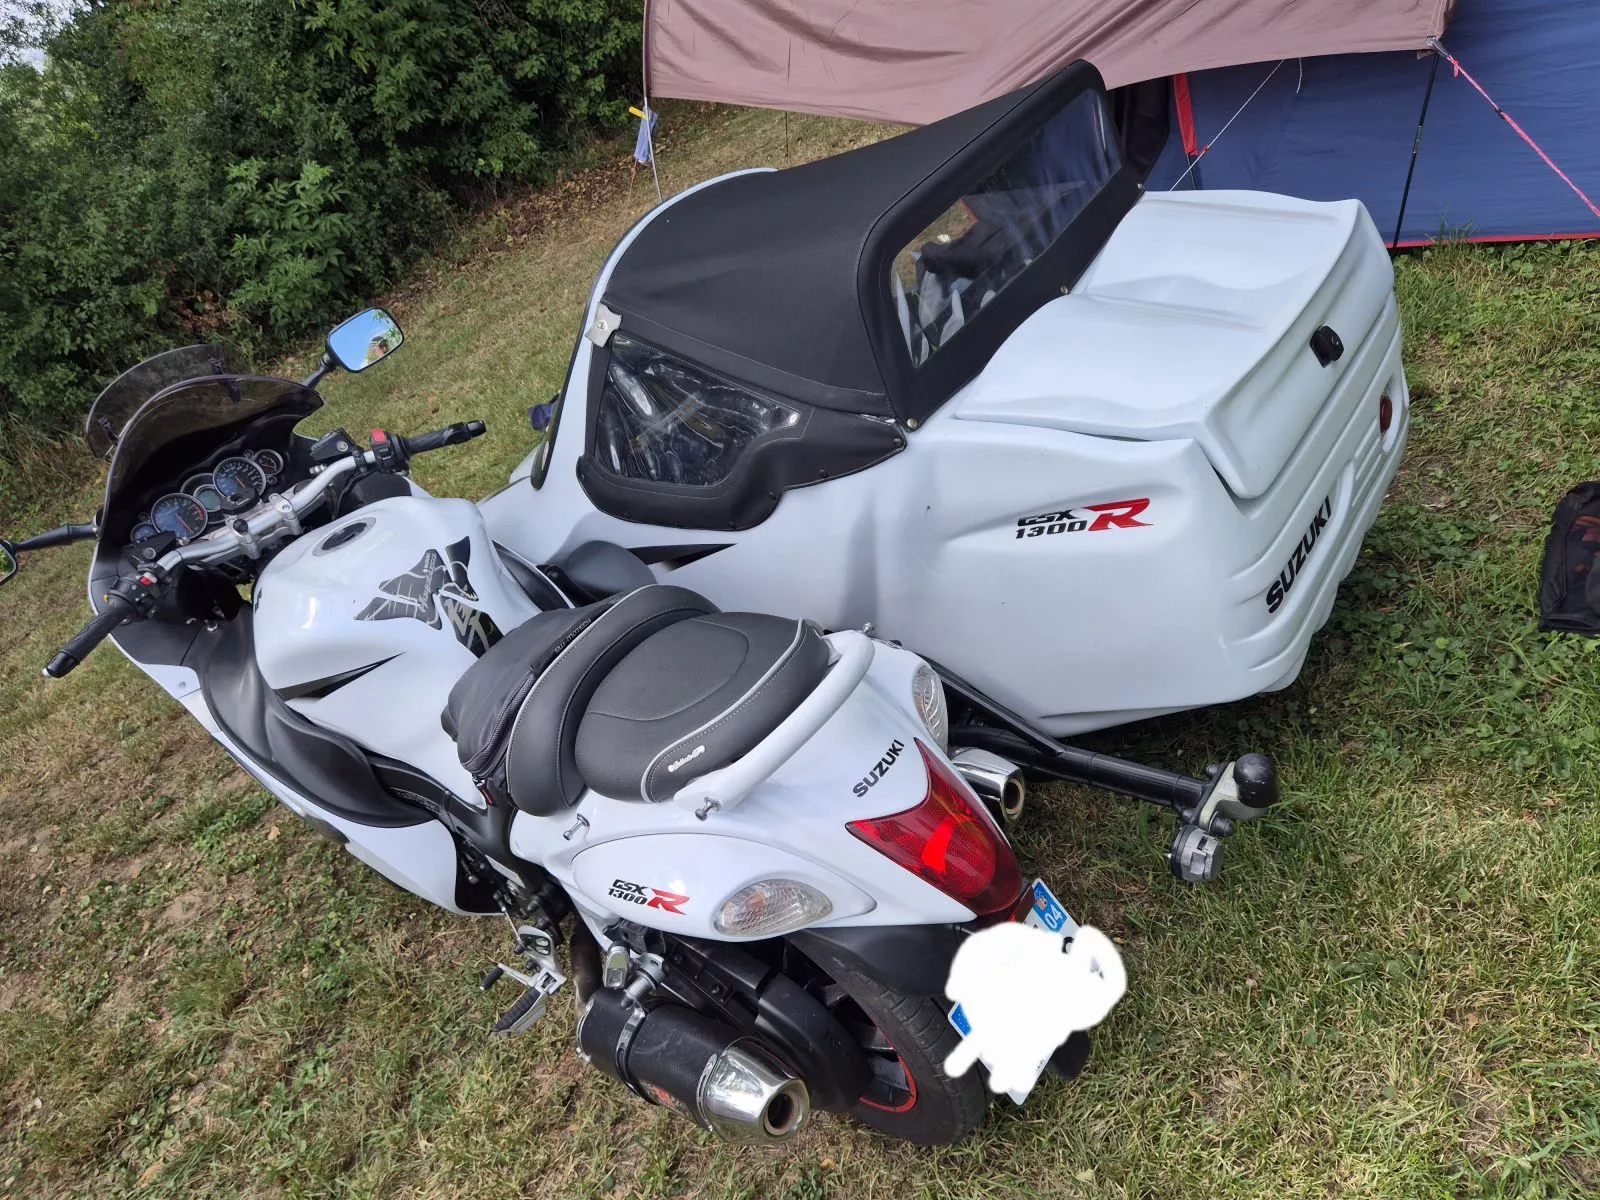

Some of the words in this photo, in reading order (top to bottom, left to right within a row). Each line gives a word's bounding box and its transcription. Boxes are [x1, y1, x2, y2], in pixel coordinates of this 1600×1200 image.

[1015, 519, 1088, 540] 1300
[1017, 508, 1081, 527] GSX
[1081, 497, 1154, 532] R
[1266, 495, 1332, 614] SUZUKI
[852, 738, 905, 798] SUZUKI
[607, 887, 649, 906] 1300
[612, 878, 650, 897] GSX
[646, 887, 690, 916] R
[1044, 903, 1064, 930] 04
